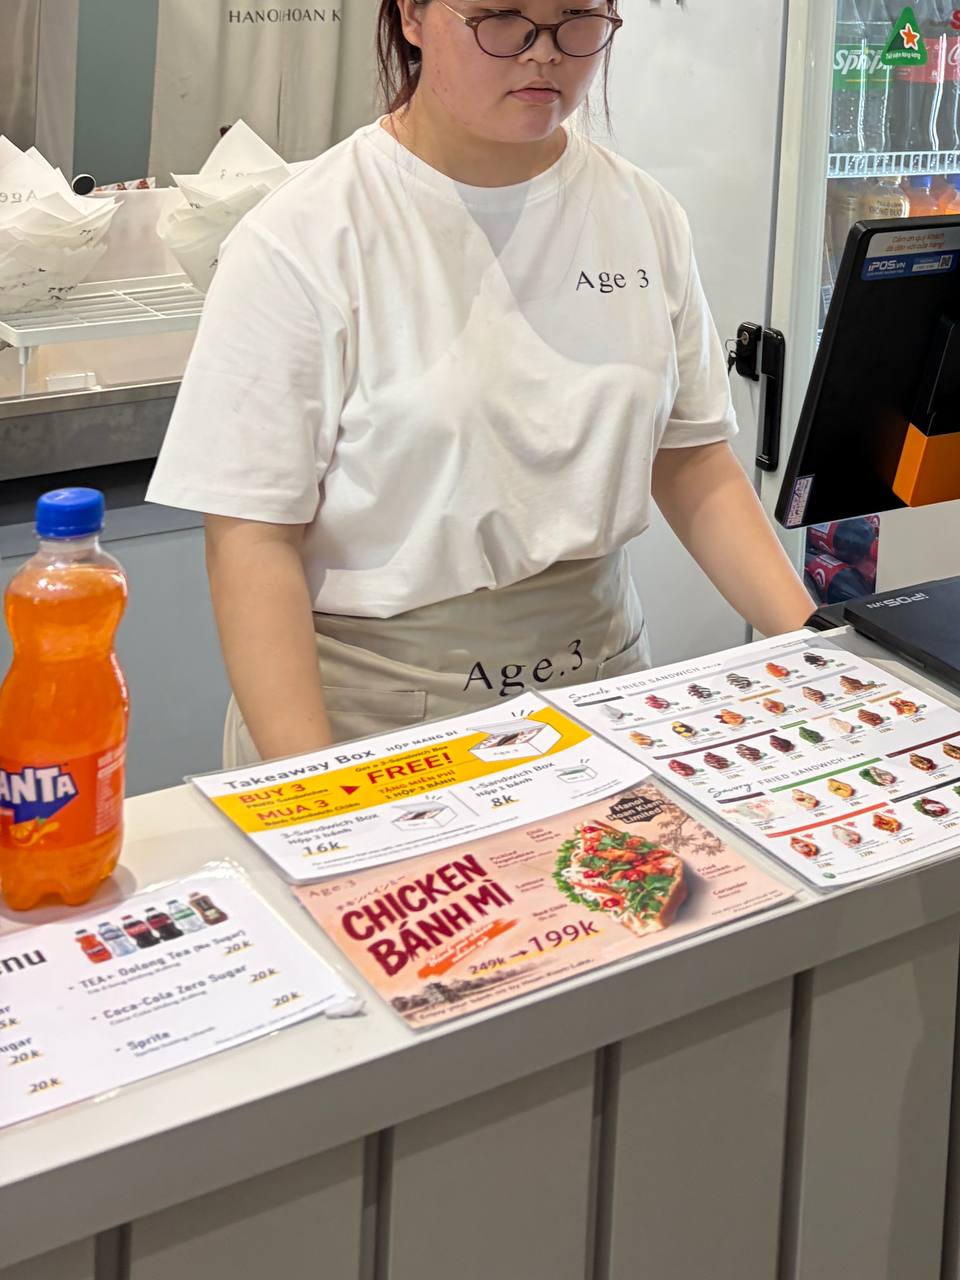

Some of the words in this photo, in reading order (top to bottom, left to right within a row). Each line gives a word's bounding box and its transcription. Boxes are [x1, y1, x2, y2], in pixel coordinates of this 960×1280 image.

[463, 639, 583, 696] Age.3
[616, 680, 648, 691] FRIED
[649, 666, 700, 684] SANDWICH
[224, 761, 329, 790] Takeaway
[334, 749, 376, 764] Box
[412, 734, 444, 745] MANG
[355, 764, 371, 772] Get
[432, 745, 448, 753] Box
[367, 752, 453, 784] FREE!
[757, 773, 790, 786] FRIED
[792, 757, 845, 776] SANDWICH
[0, 766, 76, 804] ANTA
[469, 769, 532, 792] 1-Sandwich
[533, 762, 556, 772] Box
[239, 787, 284, 804] BUY
[290, 783, 306, 793] 3
[613, 797, 645, 812] Hanoi
[256, 804, 311, 821] MUA
[314, 799, 330, 808] 3
[355, 813, 379, 823] Box
[607, 809, 637, 821] Hoan
[635, 800, 664, 812] Kiem
[622, 807, 662, 824] Limited
[304, 840, 343, 856] 16k
[341, 854, 488, 941] CHICKEN
[367, 903, 475, 977] BÁNH
[464, 878, 514, 916] MÌ
[468, 957, 505, 975] 249k
[528, 919, 600, 953] 199k
[118, 958, 166, 977] Oolong
[167, 949, 191, 960] Tea
[103, 989, 174, 1020] Coca-Cola
[176, 980, 206, 994] Zero
[208, 965, 247, 983] Sugar
[0, 1036, 33, 1053] ugar
[126, 1031, 171, 1052] Sprite
